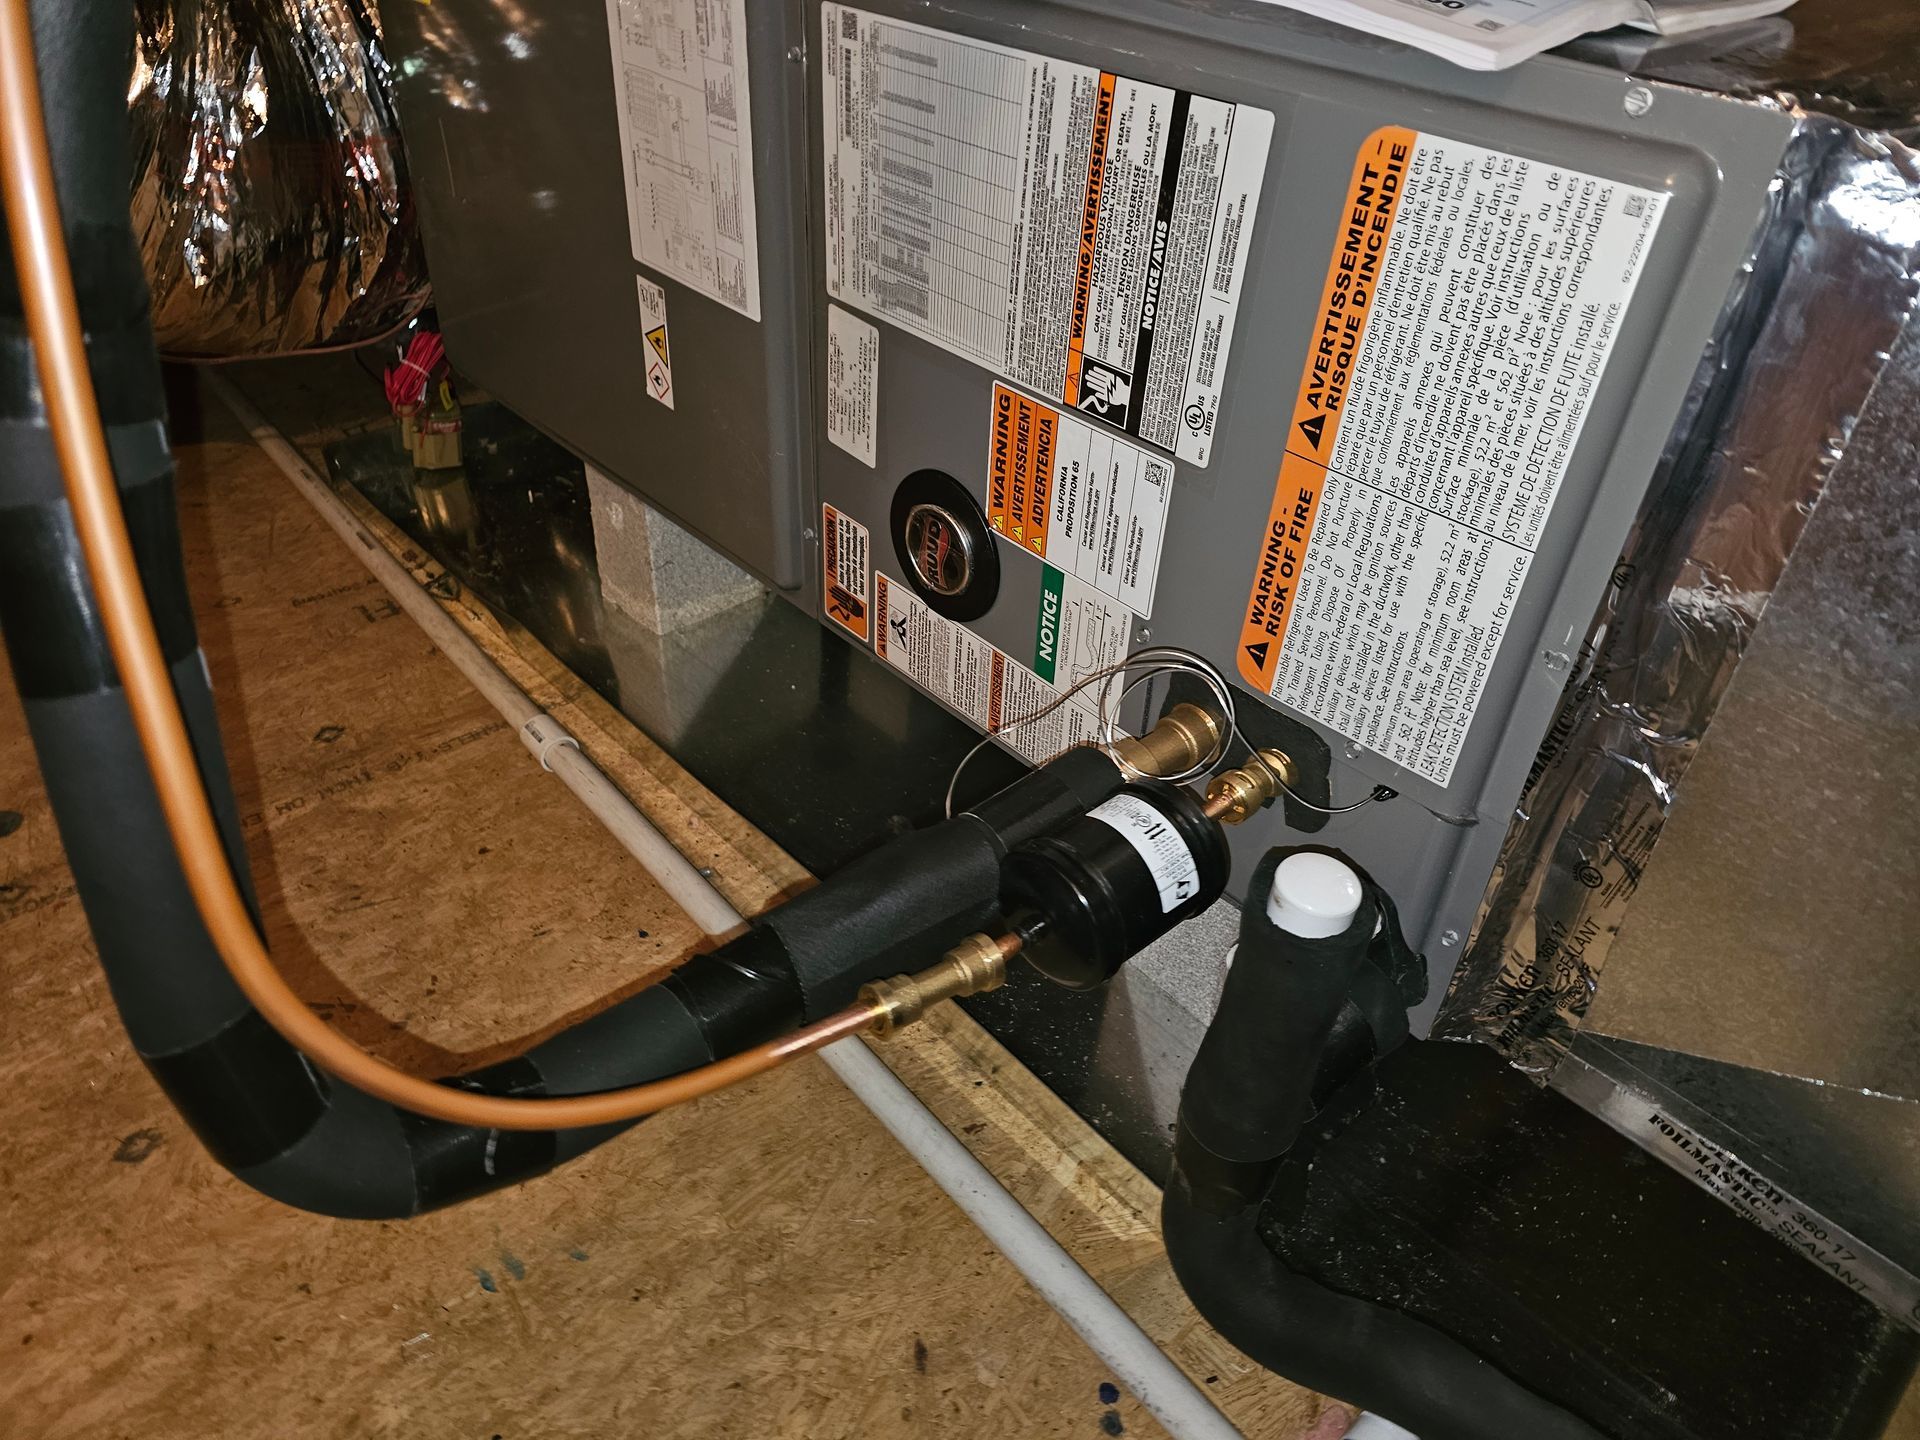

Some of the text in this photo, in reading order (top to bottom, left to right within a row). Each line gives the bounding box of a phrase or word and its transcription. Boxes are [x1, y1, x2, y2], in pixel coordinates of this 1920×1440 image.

[1142, 150, 1151, 166] OU
[1145, 135, 1153, 148] LA
[1147, 103, 1158, 133] MORT
[1072, 87, 1111, 339] WARNING/AVERTISSEMENT
[1091, 158, 1114, 288] HAZARDOUS VOLTAGE
[1093, 111, 1128, 334] CAN CAUSE SEVERE PERSONAL INJURY OR DEATH.
[1116, 164, 1142, 298] TENSION DANGEREUSE
[1133, 168, 1148, 233] CORPORELLES
[1125, 274, 1133, 292] DES
[1142, 220, 1168, 331] NOTICE/AVIS
[1306, 162, 1379, 411] AVERTISSEMENT
[1493, 213, 1531, 293] instructions
[1117, 326, 1126, 349] PEUT
[1120, 292, 1130, 326] CAUSER
[1330, 148, 1428, 471] Contient un fluide frigorigène inflammable. Ne doit être
[1384, 156, 1497, 494] Les appareils annexes qui peuvent constituer des
[1484, 294, 1504, 319] Voir
[1324, 314, 1362, 412] RISQUE
[1466, 324, 1496, 390] spécifique.
[992, 393, 1011, 509] WARNING
[1011, 400, 1032, 524] AVERTISSEMENT
[1203, 410, 1215, 437] LISTED
[1501, 303, 1601, 542] SYSTÈME DE DÉTECTION DE FUITE installé.
[1031, 418, 1053, 529] ADVERTENCIA
[1056, 466, 1069, 523] CALIFORNIA
[1064, 460, 1080, 539] PROPOSITION 65
[1428, 446, 1456, 510] concernant
[926, 519, 942, 584] RUUD
[1249, 520, 1286, 626] WARNING
[1265, 487, 1314, 637] RISK OF FIRE
[1271, 475, 1341, 700] Flammable Refrigerant Used. To Be Repaired Only
[1283, 481, 1353, 706] by Trained Service Personnel. Do Not Puncture
[877, 581, 888, 643] WARNING
[1039, 588, 1058, 662] NOTICE
[1309, 493, 1383, 719] Accordance with Federal or Local Regulations
[990, 652, 1004, 722] AVERTISSEMENT
[1418, 624, 1486, 777] LEAK DETECTION SYSTEM installed.
[1433, 555, 1528, 783] Units must be powered except for service.
[1778, 1220, 1869, 1293] SEALANT
[1791, 1212, 1858, 1262] 360-17
